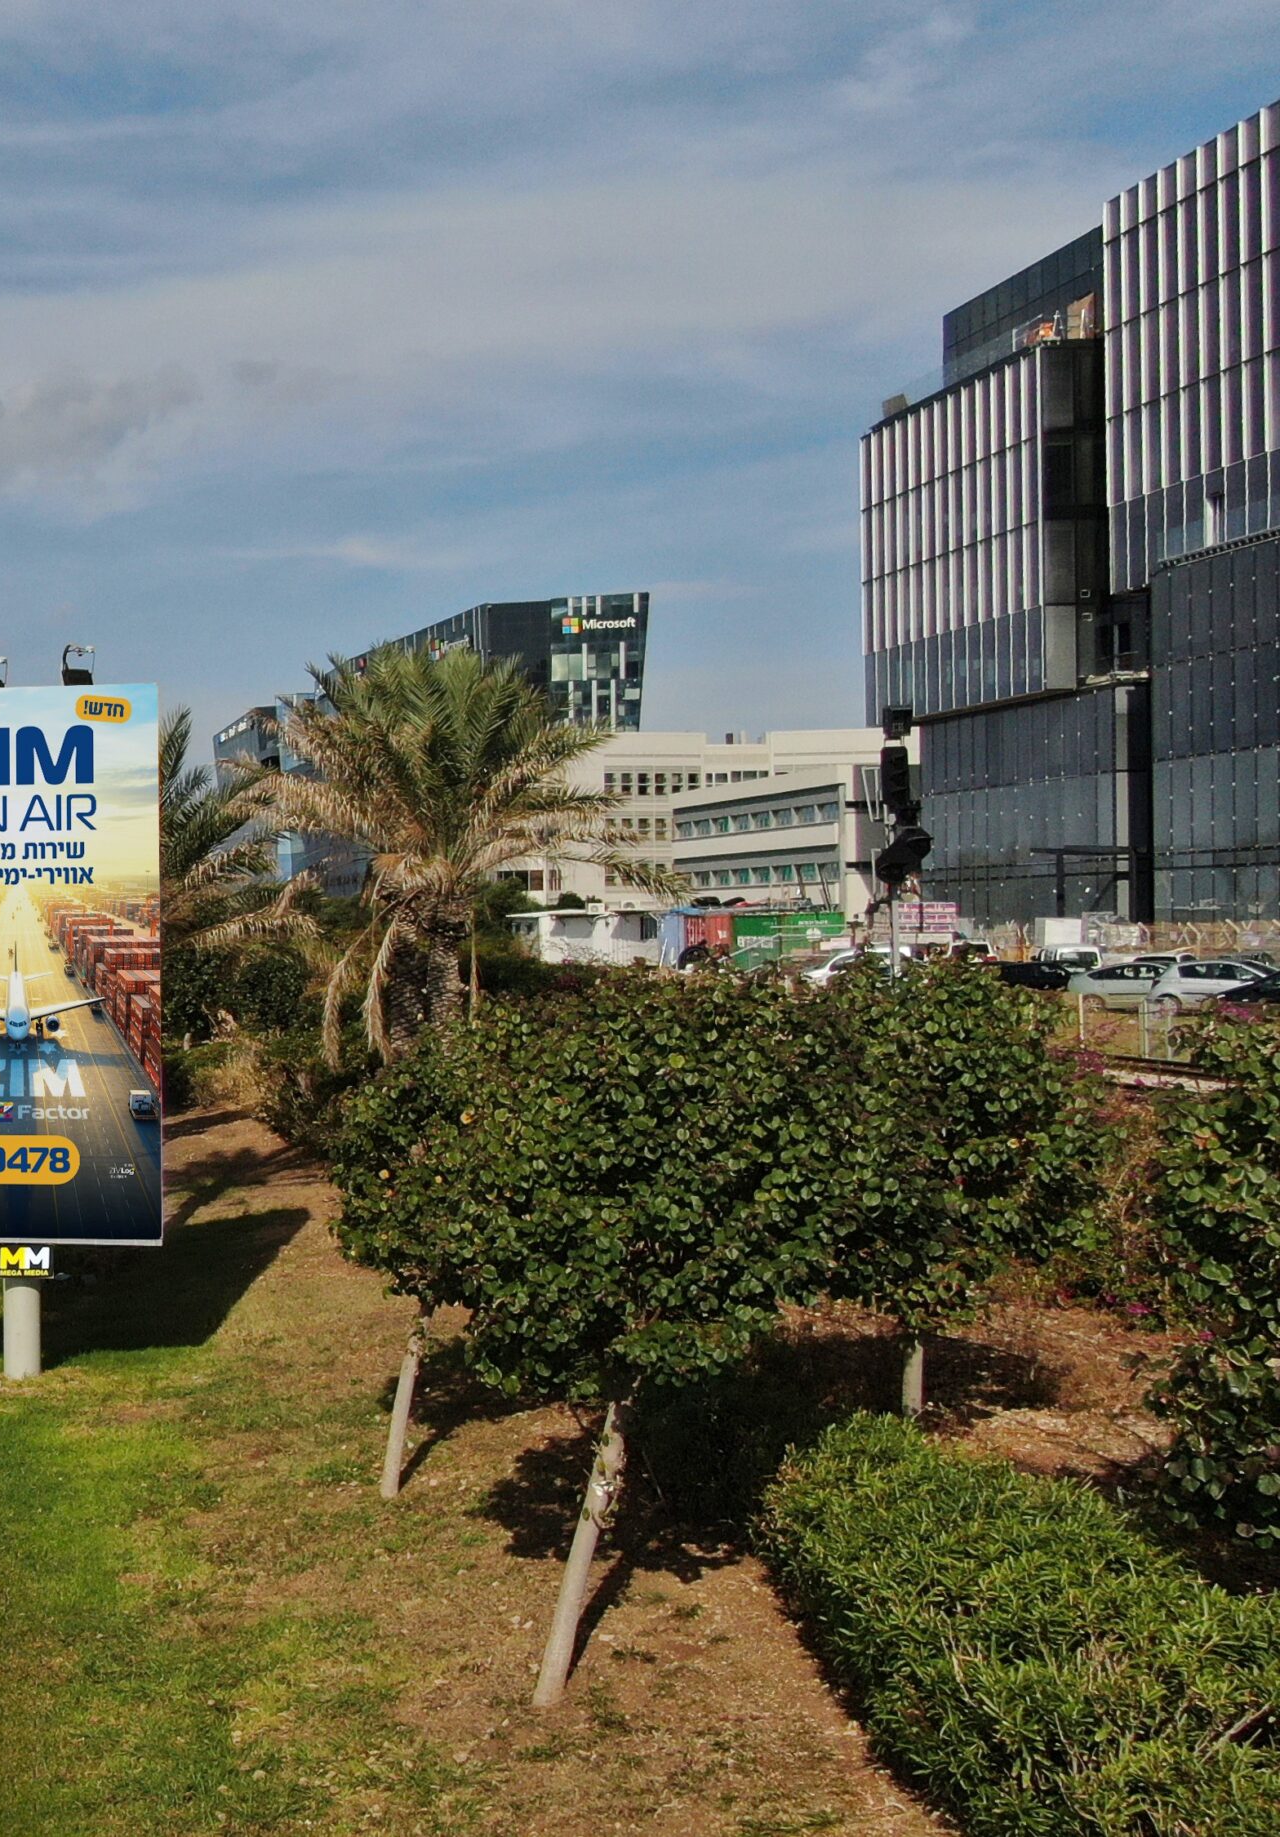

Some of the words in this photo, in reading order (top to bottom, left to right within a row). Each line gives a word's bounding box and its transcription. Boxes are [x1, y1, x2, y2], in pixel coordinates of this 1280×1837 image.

[582, 617, 637, 630] Microsoft
[83, 700, 125, 717] חדש!
[19, 794, 97, 831] AIR
[22, 841, 85, 860] שירות
[17, 1104, 91, 1120] Factor
[0, 1246, 50, 1269] MM
